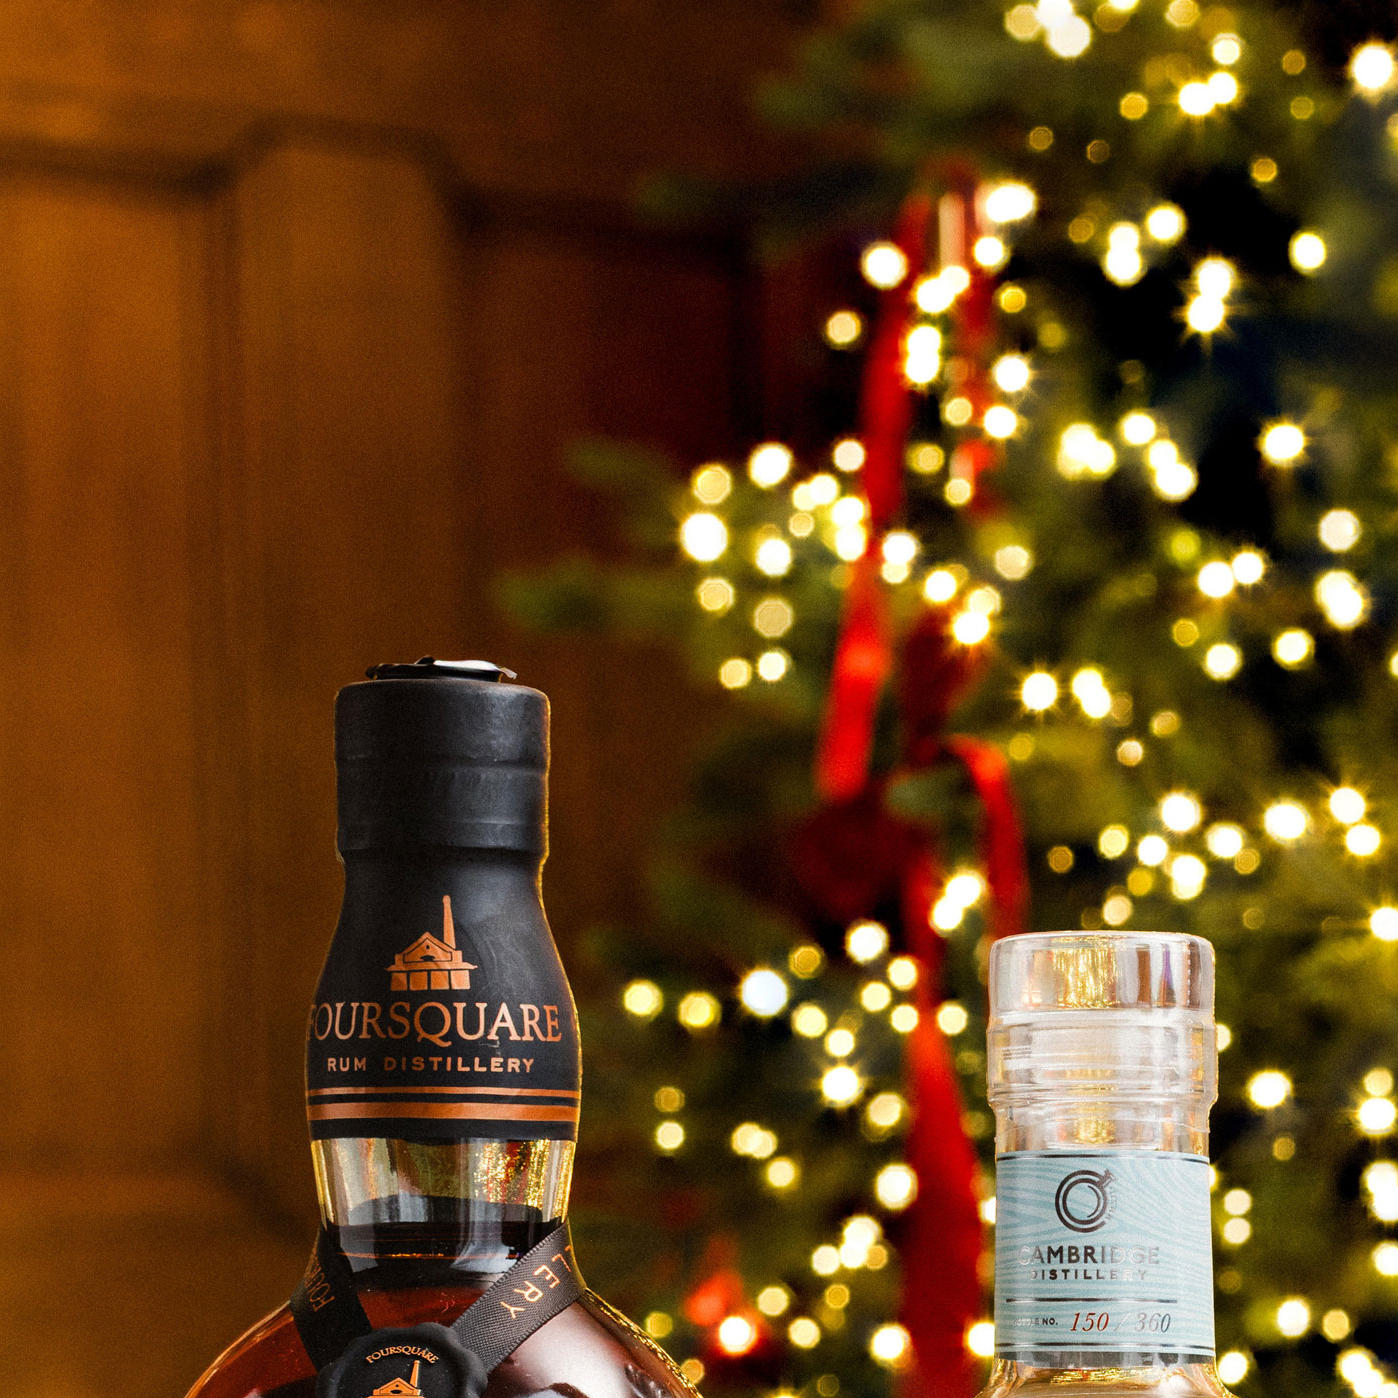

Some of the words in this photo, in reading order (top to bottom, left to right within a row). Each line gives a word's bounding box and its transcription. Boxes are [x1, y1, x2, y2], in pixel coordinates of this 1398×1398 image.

[327, 1057, 367, 1073] RUM
[384, 1056, 535, 1073] DISTILLERY
[1017, 1245, 1160, 1266] CAMBRIDGE
[1042, 1317, 1058, 1326] NO.
[1070, 1312, 1110, 1332] 150
[1134, 1313, 1172, 1333] 360
[365, 1345, 440, 1364] FOURSQUARE
